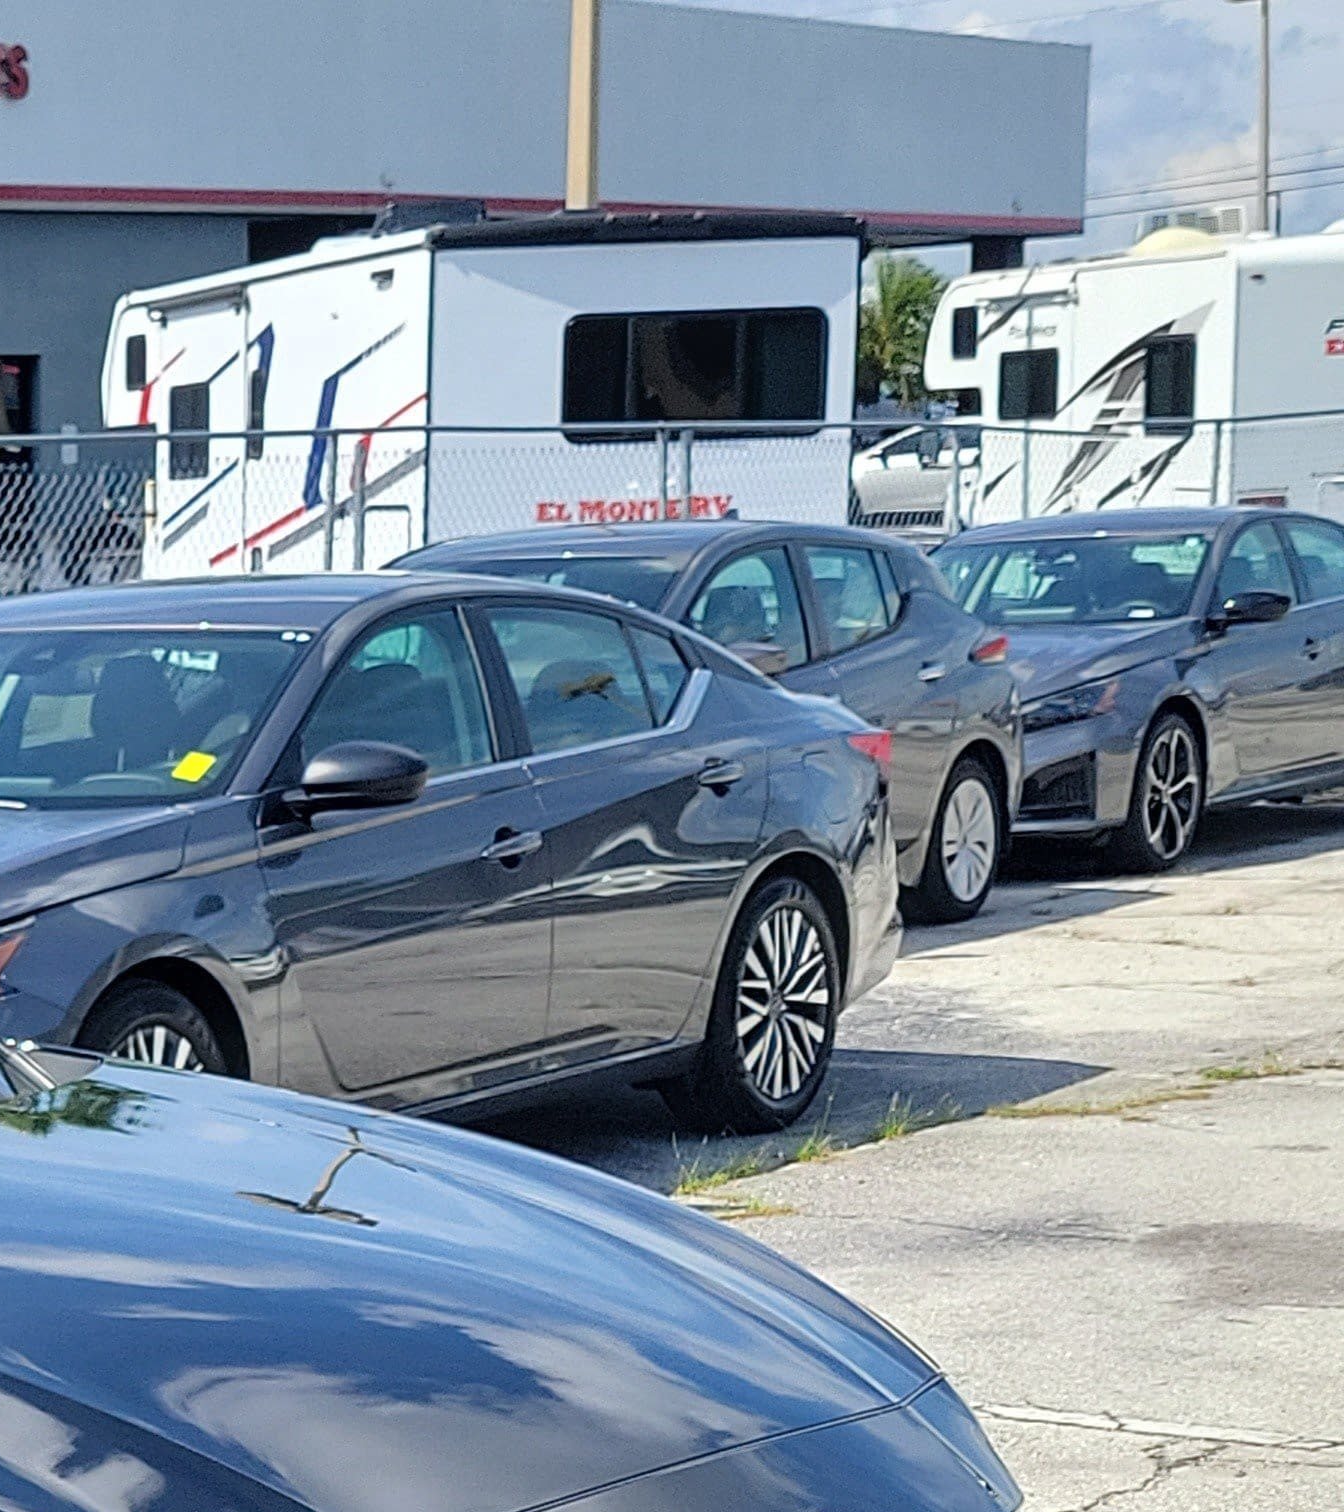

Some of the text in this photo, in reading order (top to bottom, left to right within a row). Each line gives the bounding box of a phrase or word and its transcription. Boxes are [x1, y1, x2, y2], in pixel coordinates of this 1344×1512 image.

[535, 495, 733, 523] EL MONTE RV
